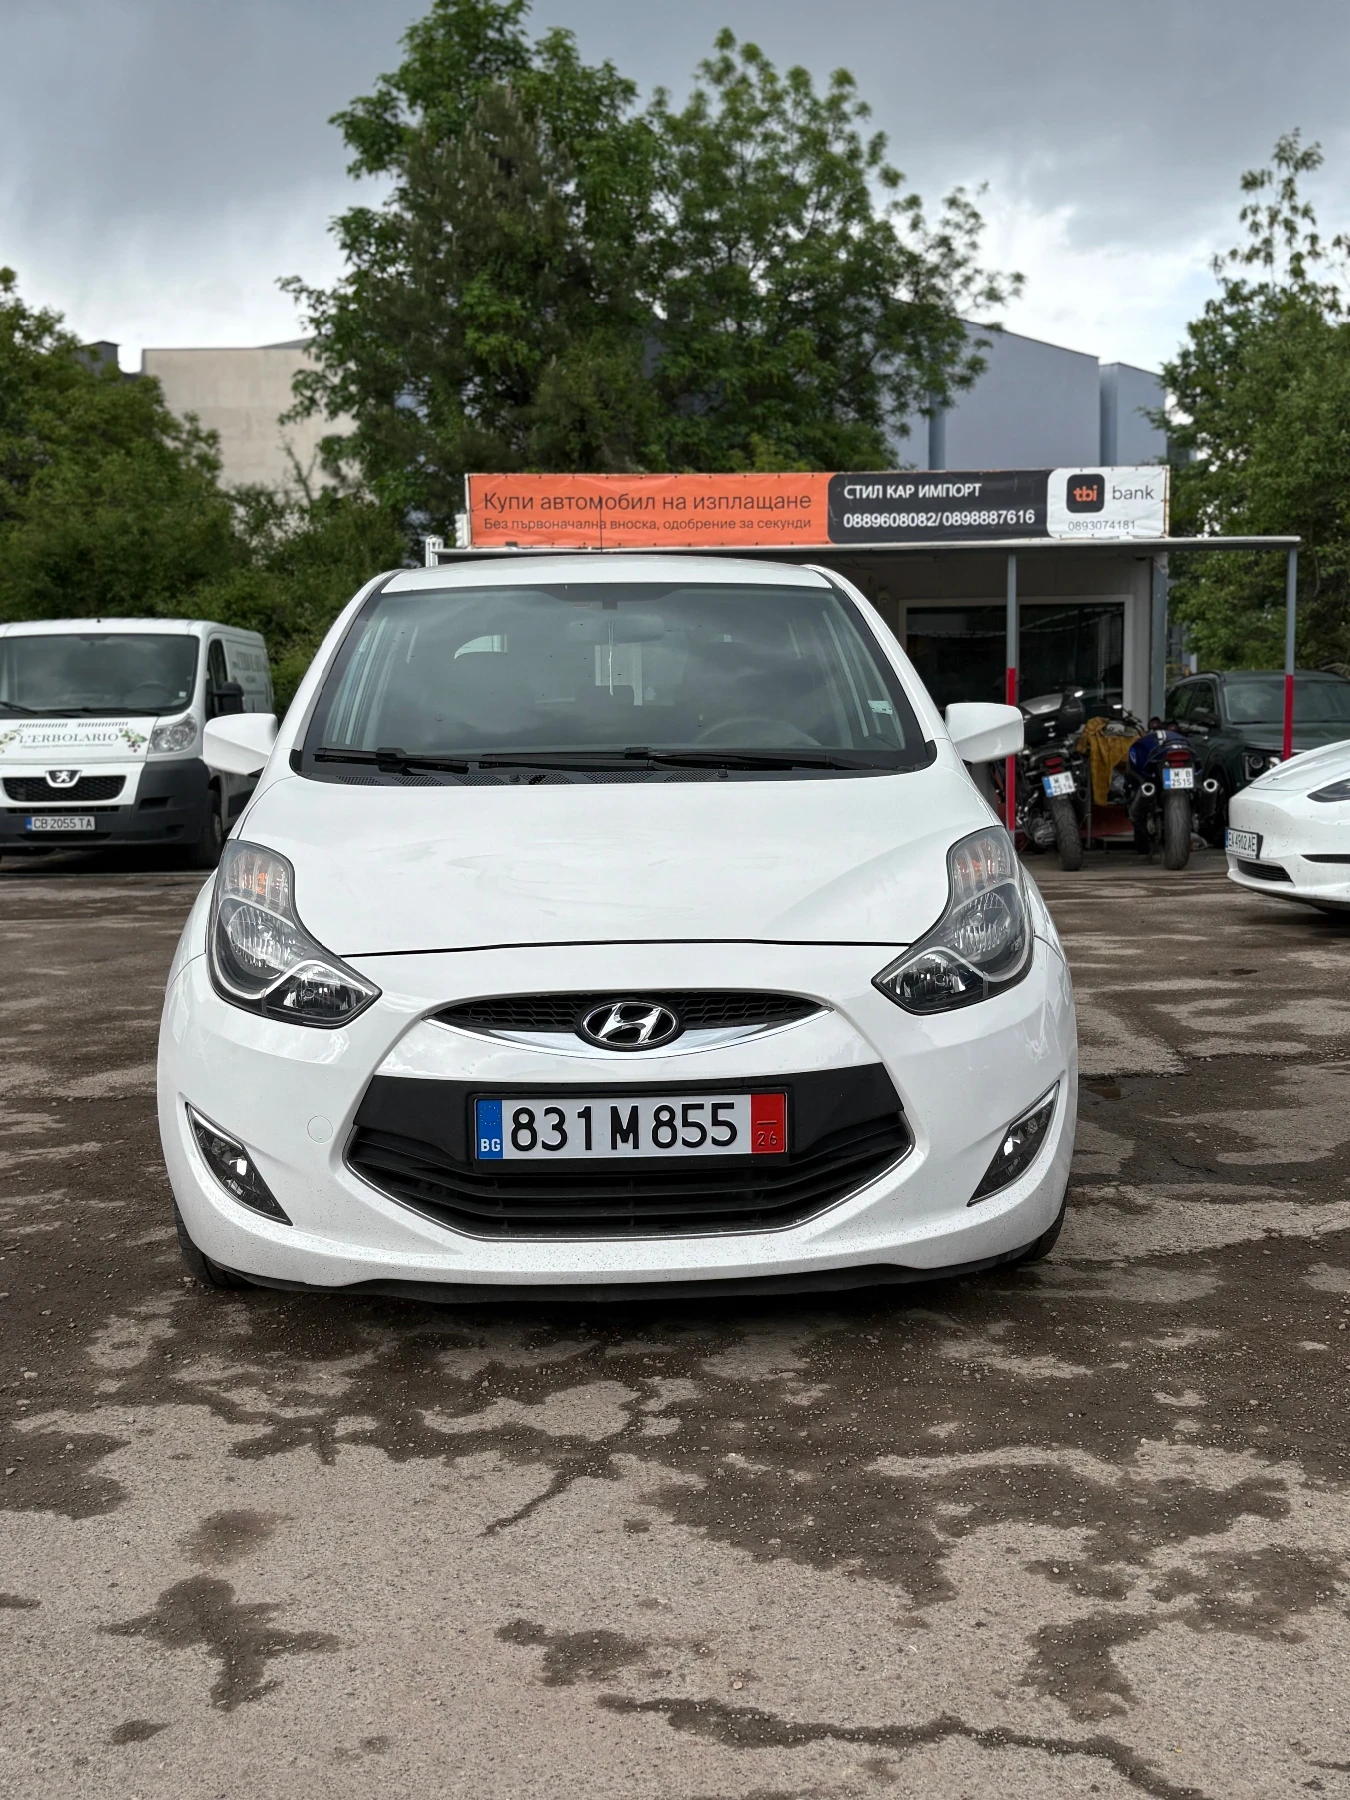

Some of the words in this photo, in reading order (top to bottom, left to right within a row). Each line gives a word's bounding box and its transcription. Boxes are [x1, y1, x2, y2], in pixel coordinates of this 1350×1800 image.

[843, 485, 882, 499] СТИЛ
[887, 485, 914, 498] КАР
[918, 483, 981, 498] ИМПОРТ
[1073, 485, 1097, 501] tbi
[1113, 485, 1154, 500] bank
[484, 493, 534, 513] Купи
[541, 493, 655, 510] автомобил
[663, 496, 686, 510] на
[694, 496, 811, 511] изплащане
[484, 518, 508, 529] Без
[512, 520, 606, 531] първоначална
[610, 519, 660, 531] вноска,
[663, 519, 736, 531] одобрение
[739, 519, 753, 529] за
[757, 519, 811, 530] секунди
[843, 510, 1035, 527] 0889608082/0898887616
[1068, 520, 1135, 531] 0893074181
[20, 733, 118, 743] L'ERBOLARIO
[1171, 778, 1192, 787] 2515
[33, 818, 48, 829] CB
[50, 818, 76, 829] 2055
[78, 818, 93, 829] TA
[510, 1105, 592, 1151] 831
[610, 1104, 640, 1150] M
[651, 1102, 738, 1149] 855
[480, 1138, 501, 1152] BG
[756, 1131, 778, 1147] 26
